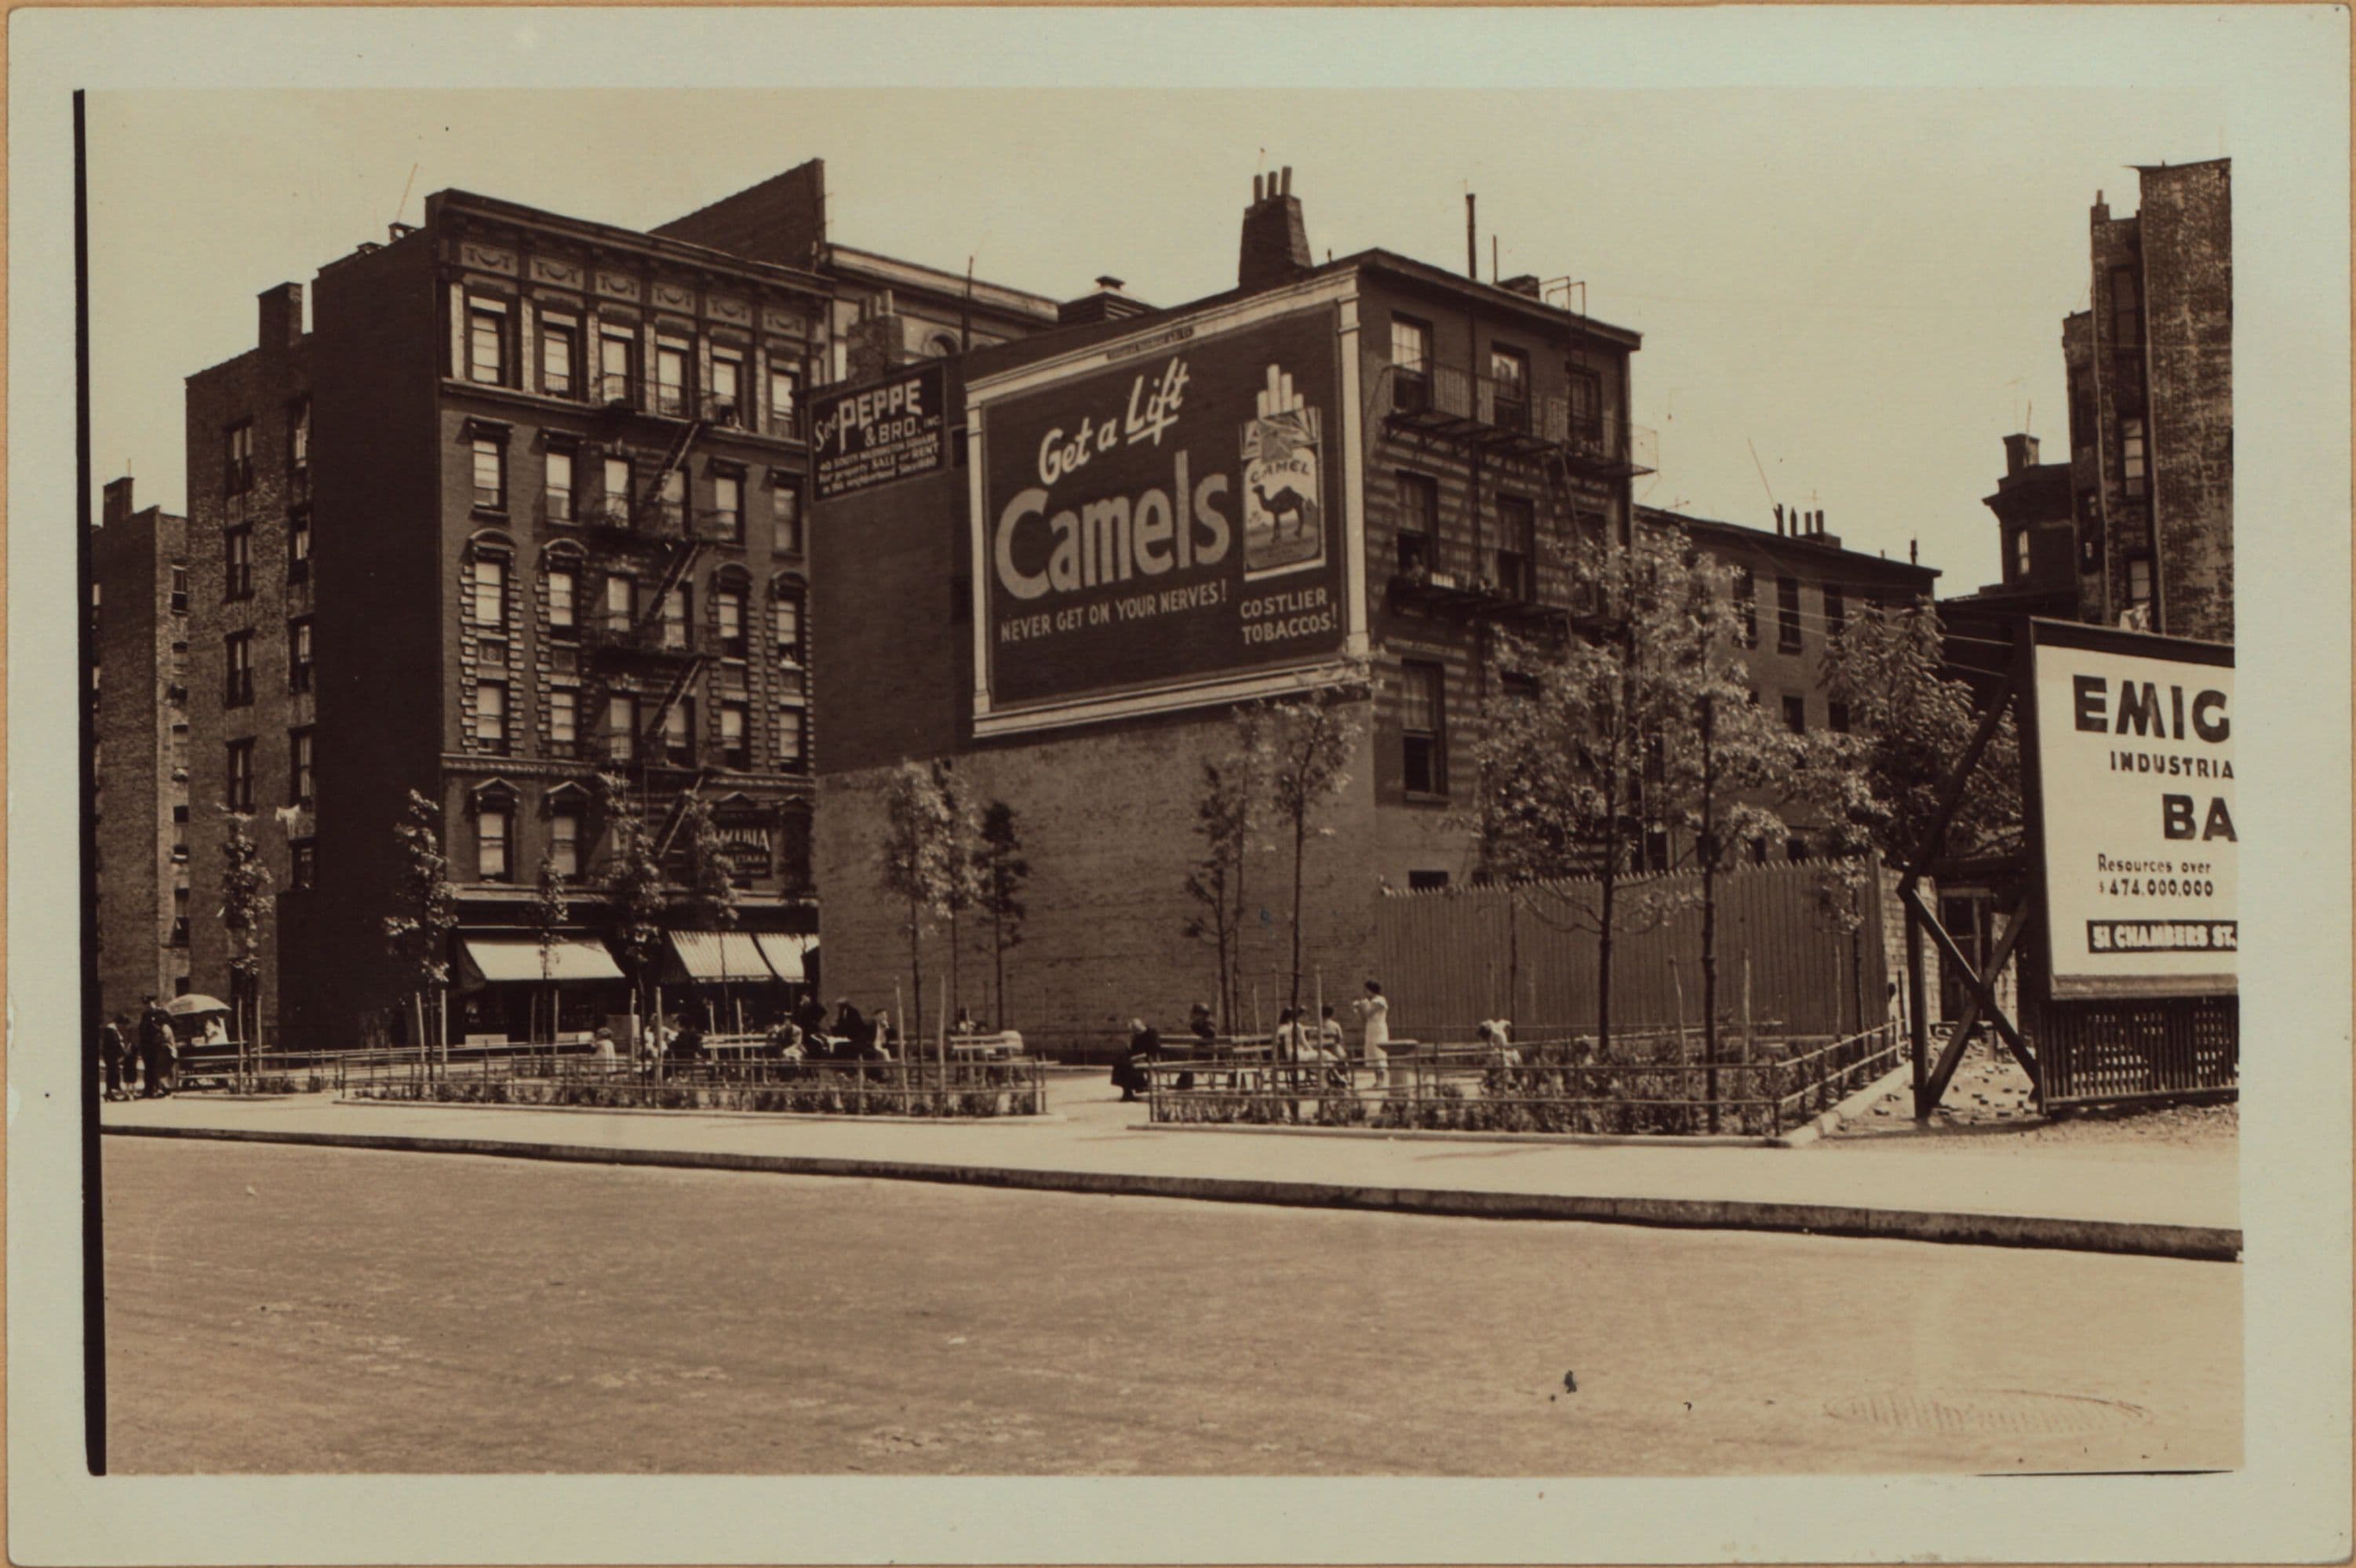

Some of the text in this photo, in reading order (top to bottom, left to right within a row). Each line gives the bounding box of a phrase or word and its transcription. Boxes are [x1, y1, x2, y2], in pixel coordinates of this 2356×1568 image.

[837, 379, 923, 454] PEPPE
[865, 426, 876, 448] &
[878, 417, 921, 444] BRO.
[1039, 356, 1189, 486] Get a Lift
[1250, 460, 1310, 484] CAMEL
[995, 450, 1230, 599] Camels
[1000, 578, 1227, 642] NEVER GET ON YOUR NERVES!
[1240, 588, 1327, 619] COSTLIER
[1242, 602, 1338, 646] TOBACCOS!
[2073, 675, 2230, 744] EMIG
[2110, 751, 2234, 779] INDUSTRIA
[2162, 793, 2238, 842] BA
[2098, 853, 2212, 875] Resources over
[2114, 924, 2209, 948] CHAMBERS
